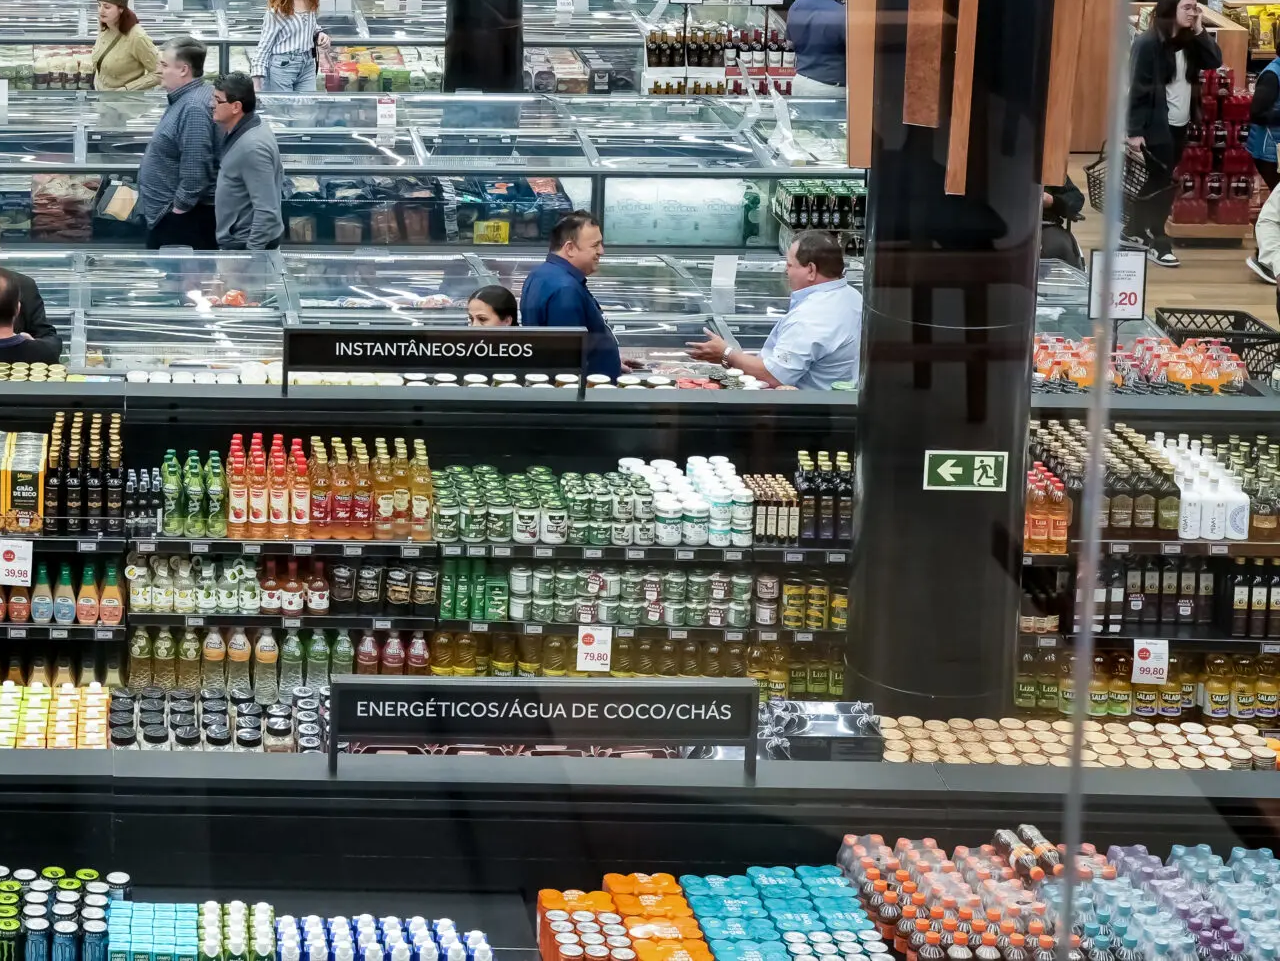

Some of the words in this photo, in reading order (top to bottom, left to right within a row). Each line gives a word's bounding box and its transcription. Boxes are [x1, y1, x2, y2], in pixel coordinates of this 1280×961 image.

[335, 340, 533, 357] INSTANTÂNEOS/ÓLEOS
[4, 568, 28, 578] 39,98
[583, 652, 608, 661] 79,80
[791, 669, 806, 678] Liza
[812, 669, 826, 678] Liza
[1139, 666, 1164, 676] 99,80
[1019, 684, 1035, 692] Liza
[1042, 684, 1058, 692] Liza
[356, 697, 566, 720] ENERGÉTICOS/ÁGUA
[569, 703, 599, 720] DE
[603, 697, 732, 720] COCO/CHÁS
